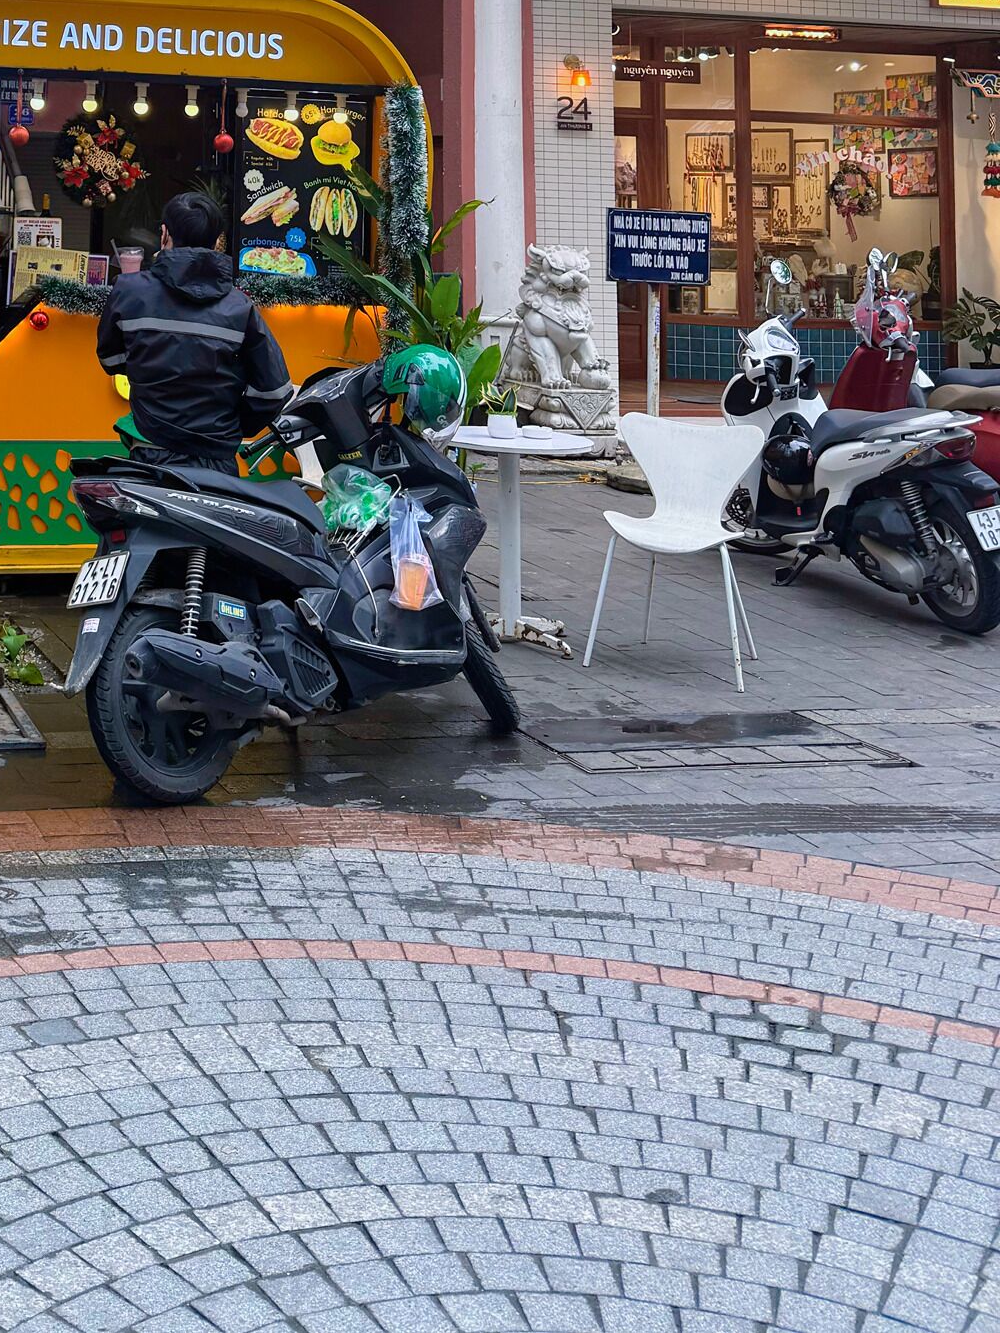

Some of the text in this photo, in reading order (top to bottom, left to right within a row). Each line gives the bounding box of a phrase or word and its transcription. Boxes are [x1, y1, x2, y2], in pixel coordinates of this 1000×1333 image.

[59, 22, 124, 52] AND
[135, 26, 285, 60] DELICIOUS
[257, 107, 285, 119] Hotdo
[320, 105, 367, 122] Hamurger
[556, 96, 592, 121] 24
[246, 179, 284, 203] Sandwich
[303, 177, 322, 190] Banh
[613, 213, 624, 229] NHÀ
[625, 213, 633, 229] CÓ
[633, 216, 640, 230] XE
[652, 217, 660, 231] RA
[241, 237, 286, 248] Carbonara
[614, 234, 626, 248] XIN
[627, 234, 639, 249] VUI
[640, 233, 657, 250] LÒNG
[658, 235, 681, 251] KHÔNG
[697, 239, 706, 253] XE
[631, 251, 689, 270] TRƯỚC LỐI RA VÀO
[670, 271, 681, 281] XIN
[976, 510, 1000, 529] 43-
[83, 556, 119, 582] 74-L1
[71, 578, 118, 604] 312.16
